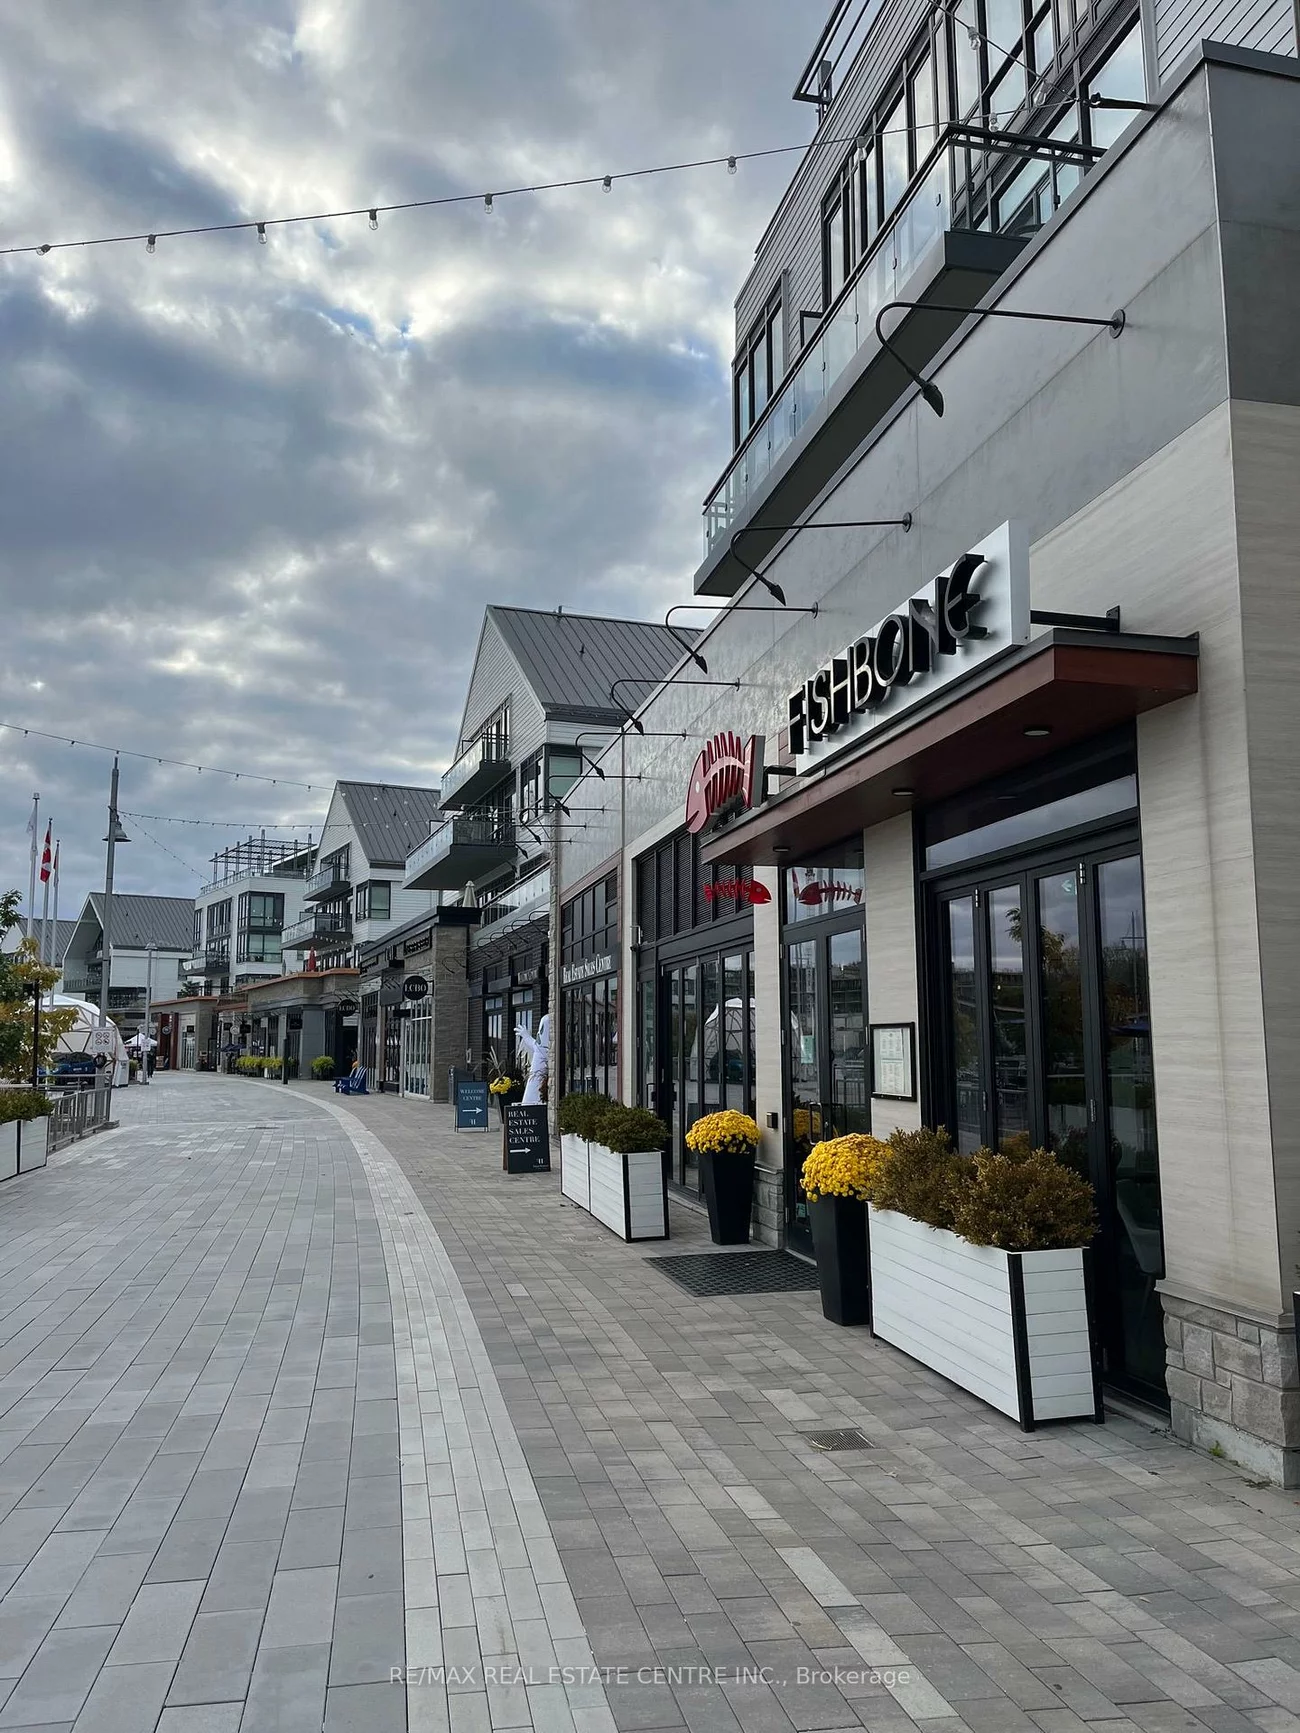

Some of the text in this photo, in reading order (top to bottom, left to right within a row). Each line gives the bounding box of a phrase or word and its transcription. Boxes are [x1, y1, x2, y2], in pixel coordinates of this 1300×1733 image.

[788, 553, 988, 755] FISHBONE
[404, 983, 427, 992] LCBO
[508, 1110, 529, 1118] REAL
[508, 1119, 538, 1127] ESTATE
